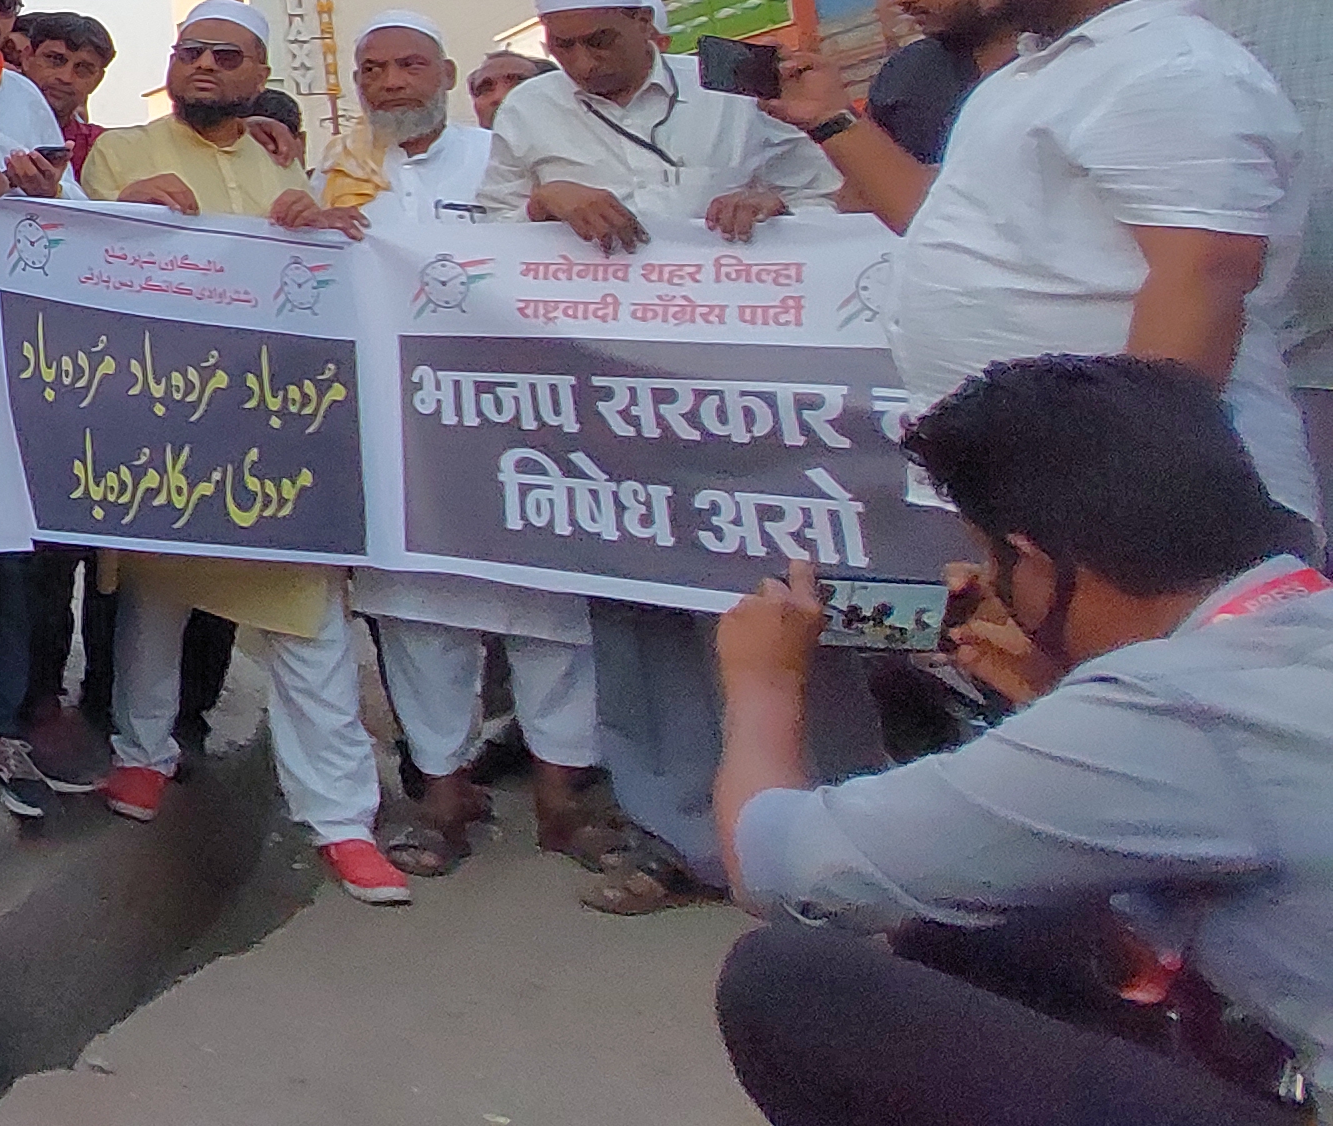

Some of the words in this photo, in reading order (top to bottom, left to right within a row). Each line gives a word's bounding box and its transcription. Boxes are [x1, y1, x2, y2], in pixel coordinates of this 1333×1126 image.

[516, 293, 621, 324] राष्ट्रवादी
[737, 294, 806, 327] पार्टी
[641, 262, 704, 286] शहर
[713, 254, 807, 286] जिल्हा
[411, 365, 580, 433] भाजप
[590, 375, 851, 448] सरकार
[152, 442, 224, 529] سرکار
[226, 447, 313, 527] مودی
[497, 447, 674, 547] निषेध
[694, 469, 872, 568] असो
